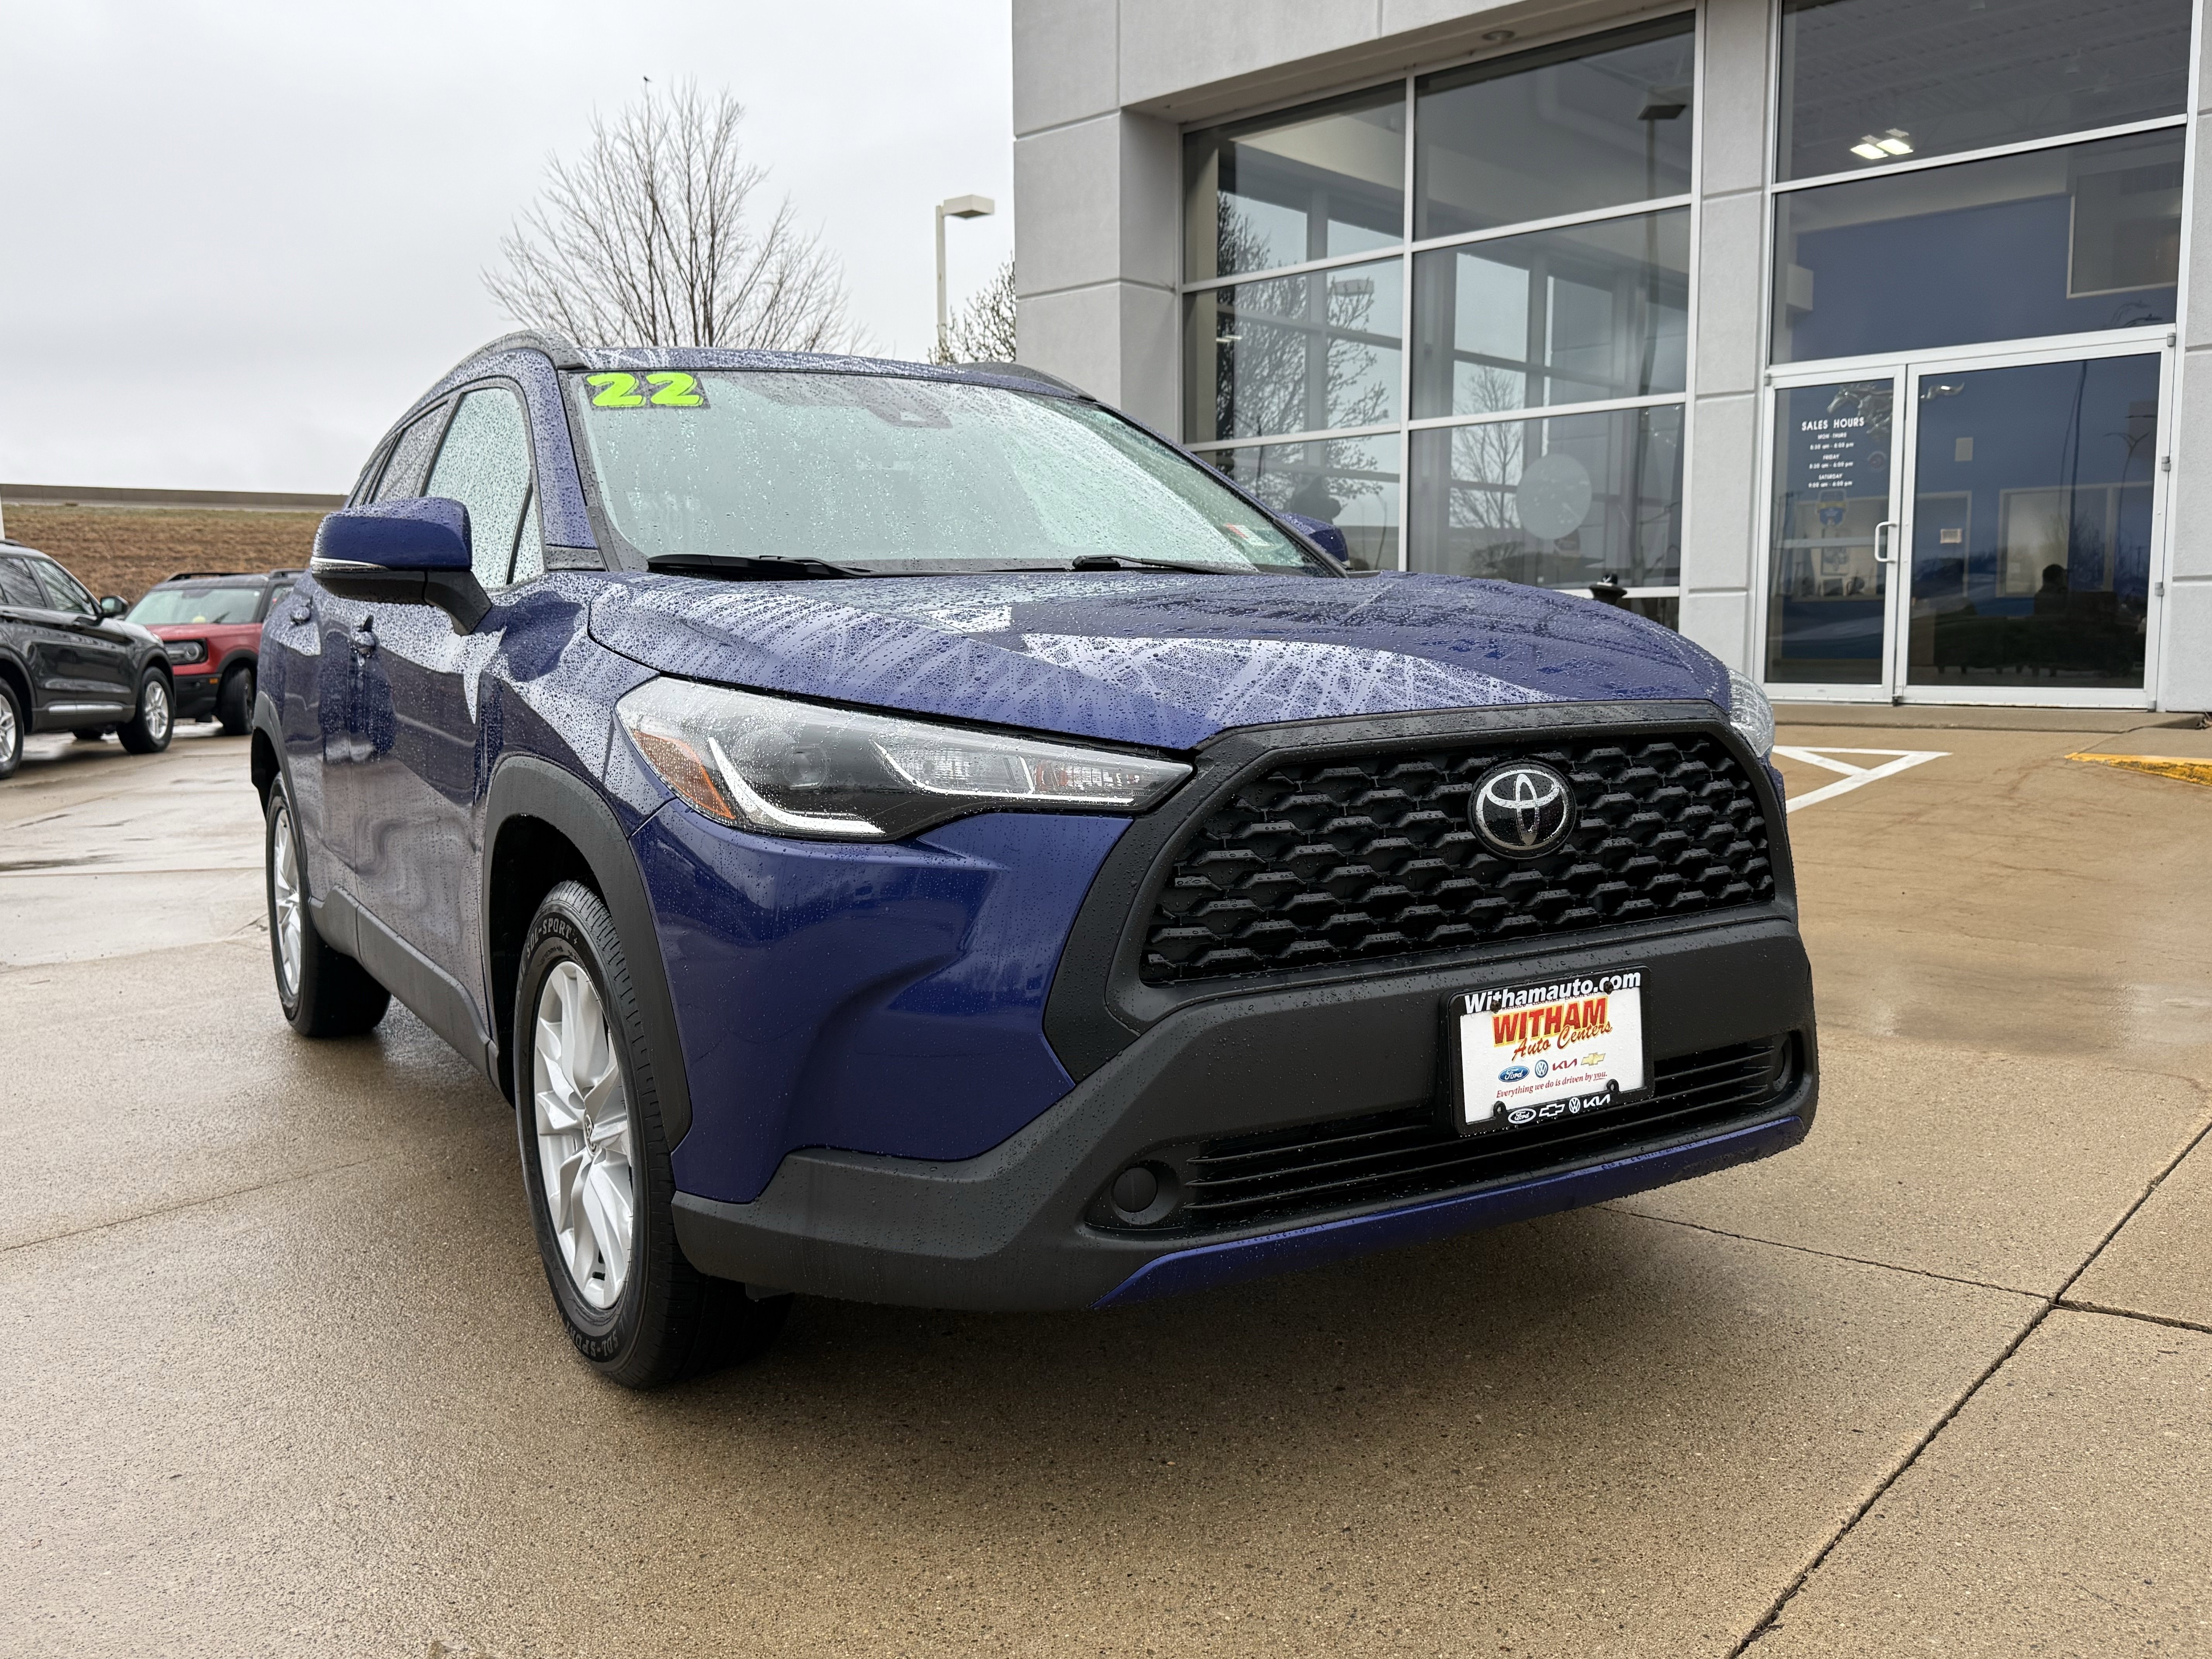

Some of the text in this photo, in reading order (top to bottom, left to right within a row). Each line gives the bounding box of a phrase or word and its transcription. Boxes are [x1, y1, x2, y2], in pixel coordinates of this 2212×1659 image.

[586, 372, 704, 407] 22
[1802, 416, 1865, 431] SALES HOURS
[1492, 997, 1607, 1045] WITHAM
[1512, 1021, 1613, 1062] Auto Centers
[1496, 1085, 1533, 1098] Everything
[1562, 1075, 1583, 1085] driven
[1585, 1073, 1593, 1082] by
